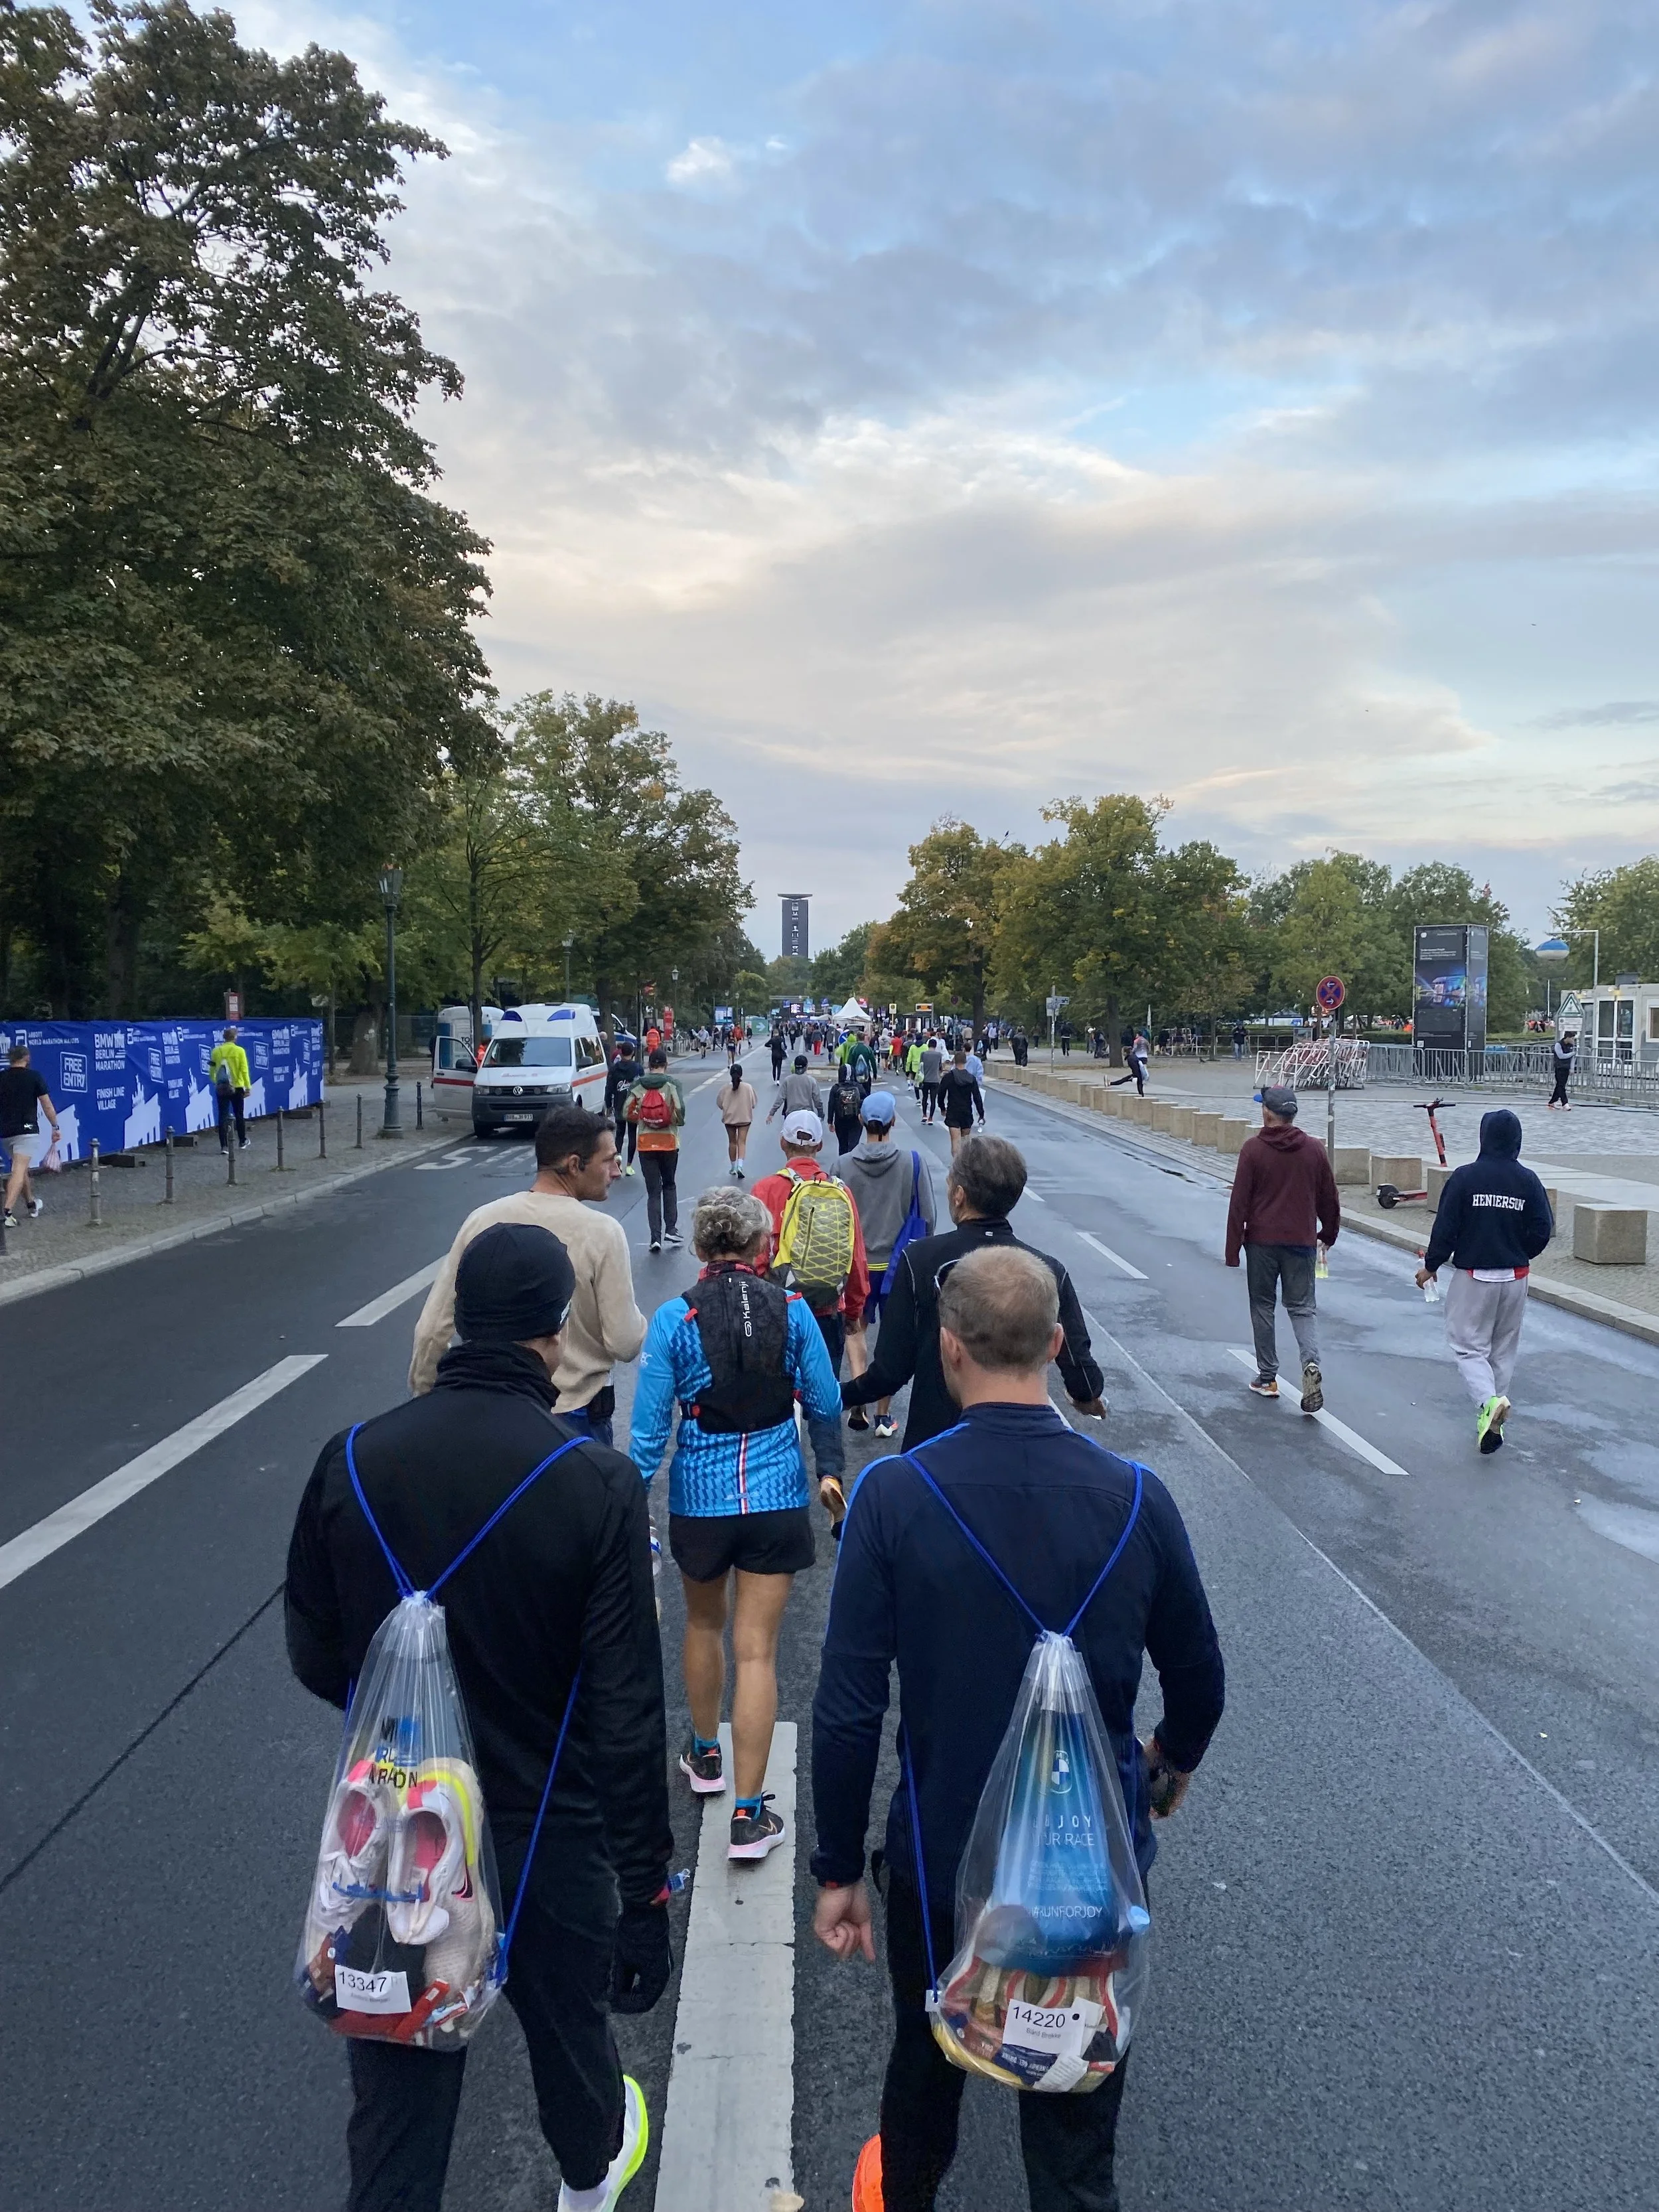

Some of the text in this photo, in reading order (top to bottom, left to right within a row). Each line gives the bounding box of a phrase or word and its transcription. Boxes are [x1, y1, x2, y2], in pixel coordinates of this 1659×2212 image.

[94, 1033, 113, 1048] BMW
[95, 1049, 114, 1059] BERLIN
[64, 1057, 82, 1072] FREE
[95, 1060, 125, 1070] MARATHON
[63, 1072, 85, 1088] ENTRY
[96, 1086, 125, 1099] FINISH LINE
[97, 1099, 116, 1110] VILLAGE
[739, 1281, 751, 1319] Kalenji
[1065, 1832, 1096, 1846] RACE
[339, 1971, 387, 1992] 13347
[1013, 2006, 1066, 2028] 14220
